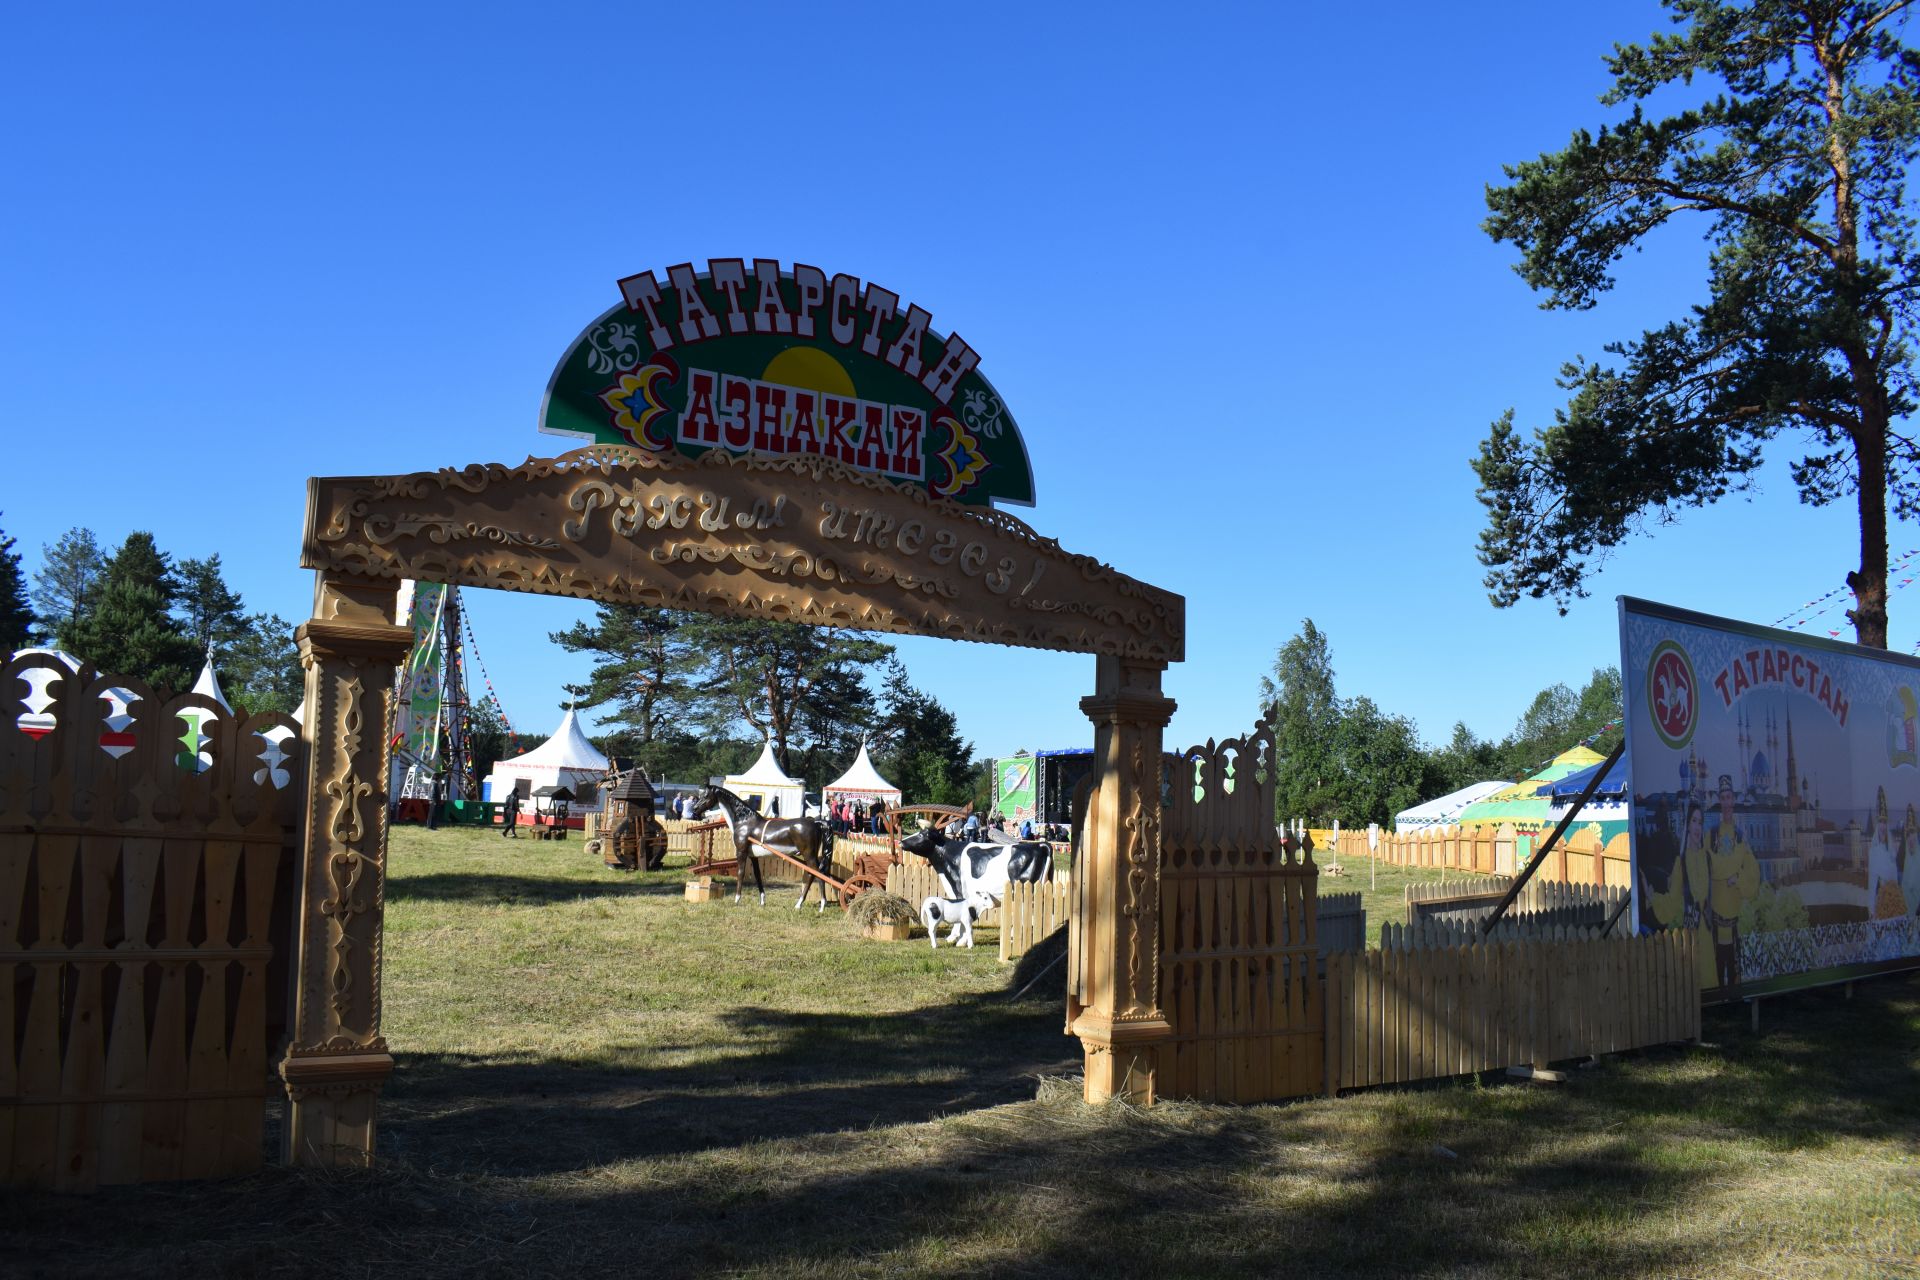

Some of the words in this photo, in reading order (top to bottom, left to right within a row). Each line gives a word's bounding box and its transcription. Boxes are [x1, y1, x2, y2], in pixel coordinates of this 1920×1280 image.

[618, 258, 981, 405] ТАТАРСТАН
[680, 368, 926, 480] АЗНАКАЙ
[563, 481, 786, 541] Рәхим
[1715, 649, 1849, 727] ТАТАРСТАН
